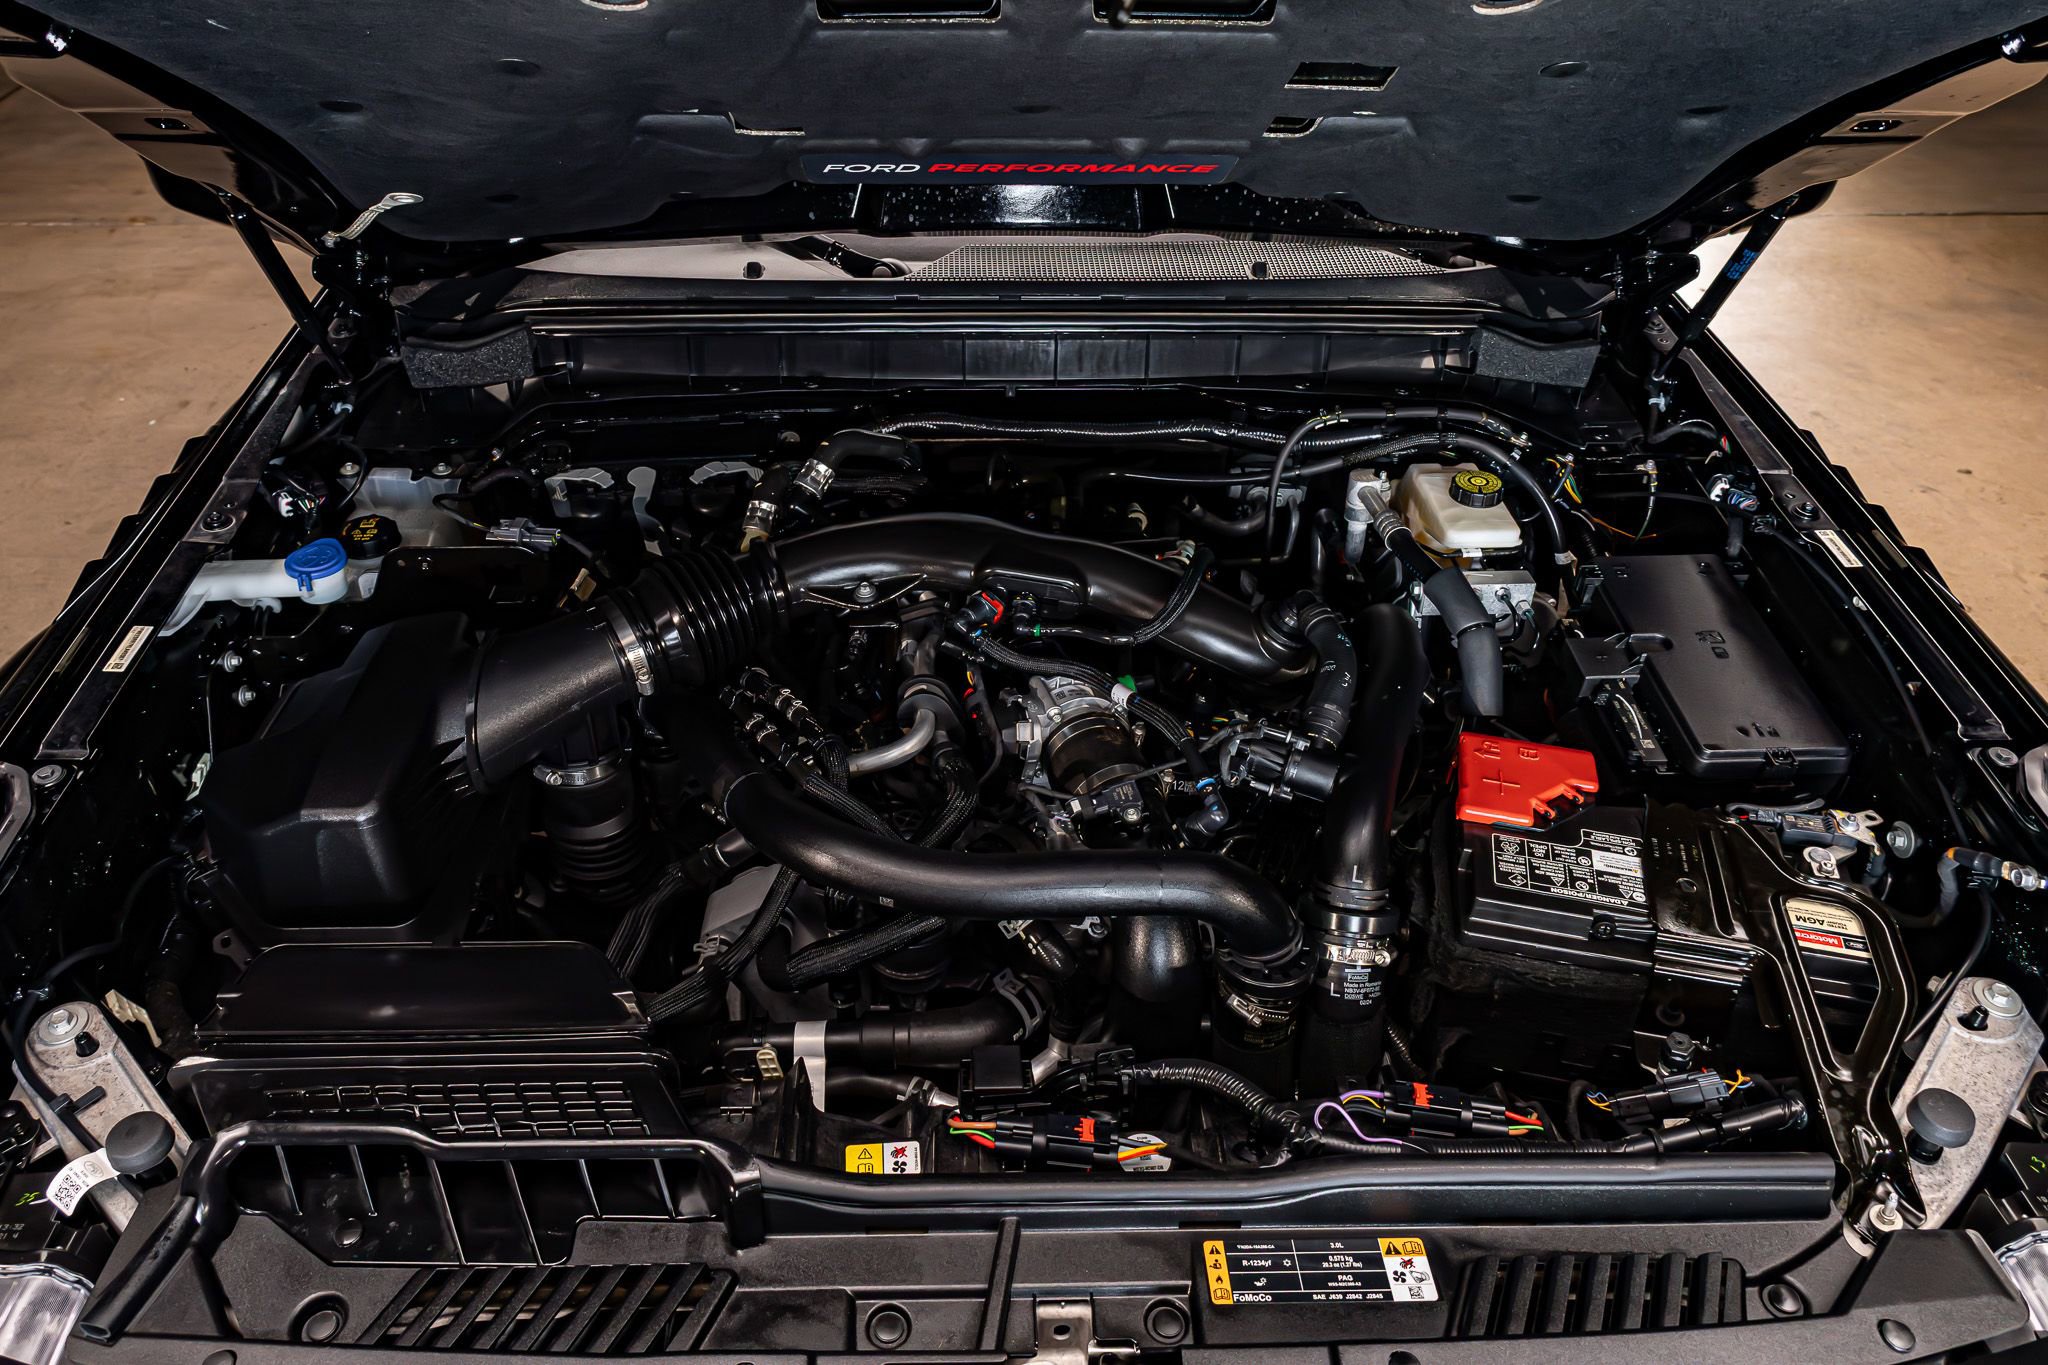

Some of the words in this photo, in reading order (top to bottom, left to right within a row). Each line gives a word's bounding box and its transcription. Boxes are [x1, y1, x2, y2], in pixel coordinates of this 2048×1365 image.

[822, 164, 920, 174] FORD
[927, 164, 1220, 174] PERFORMANCE
[1352, 864, 1364, 884] L
[1795, 915, 1824, 925] AGM
[1330, 982, 1340, 997] L
[1233, 1293, 1272, 1302] FoMoCo
